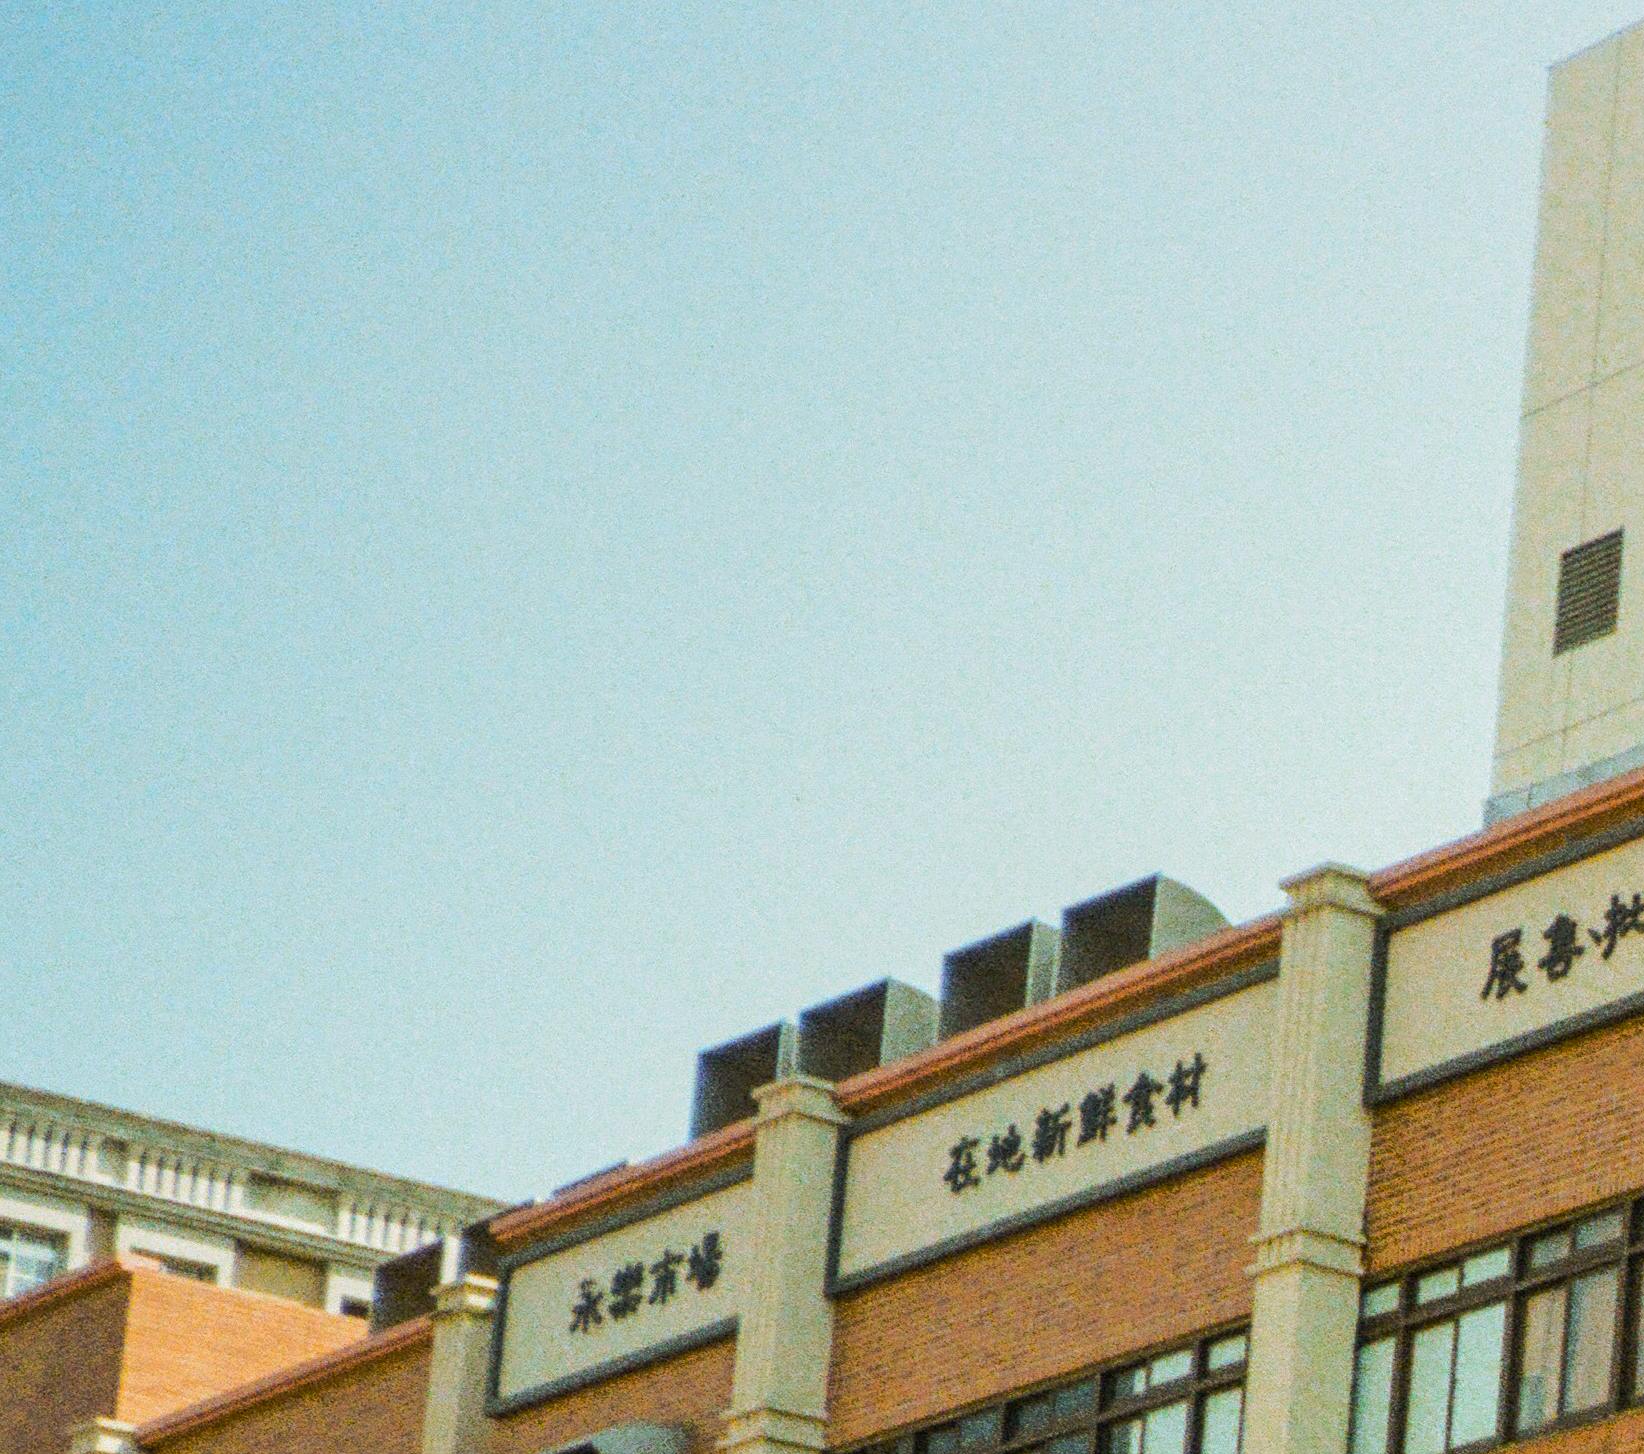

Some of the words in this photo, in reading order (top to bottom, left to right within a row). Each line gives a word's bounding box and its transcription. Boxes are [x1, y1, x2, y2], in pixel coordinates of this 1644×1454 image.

[942, 1051, 1207, 1195] 在地新鮮食材
[569, 1230, 724, 1336] 永樂市場
